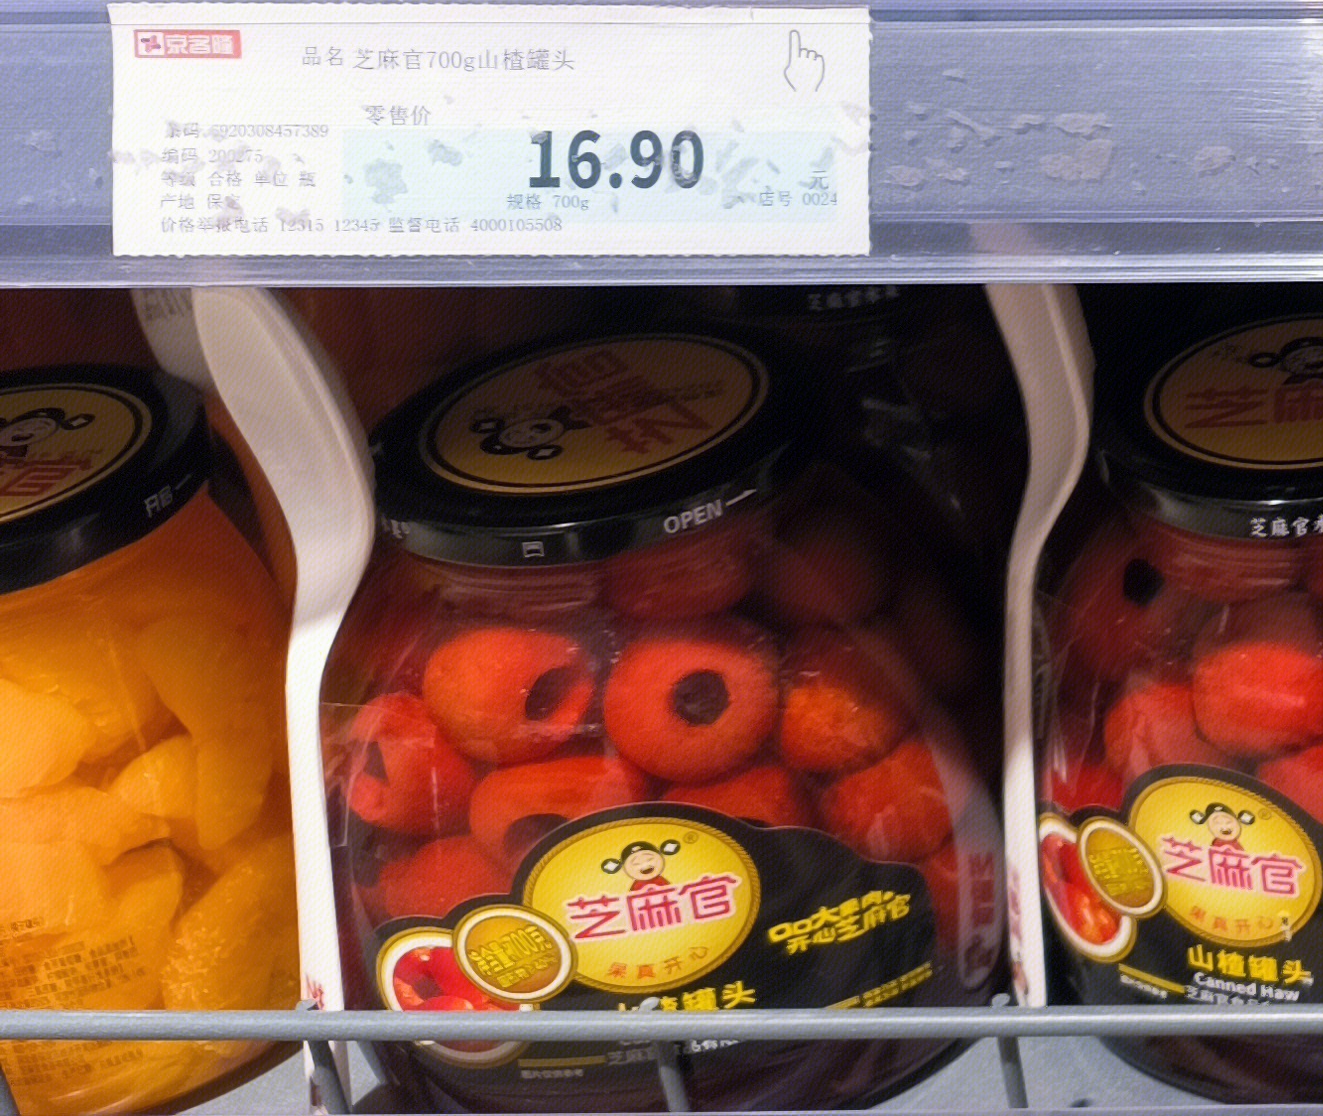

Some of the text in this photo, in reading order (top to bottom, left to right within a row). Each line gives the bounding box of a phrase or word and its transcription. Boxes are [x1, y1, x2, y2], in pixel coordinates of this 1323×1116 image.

[302, 46, 575, 72] 品名 芝麻官700g山楂罐头
[365, 105, 432, 126] 零售价
[162, 147, 198, 164] 编码
[529, 129, 704, 190] 16.90
[208, 171, 242, 187] 合格
[254, 171, 289, 187] 单位
[299, 171, 316, 187] 瓶
[810, 170, 829, 191] 元
[160, 193, 195, 210] 产地
[507, 194, 590, 211] 规格 700g
[758, 190, 838, 207] 店号 0024
[161, 216, 563, 233] 价格举报电话 12315 12345 监督电话 4000105508
[664, 499, 723, 535] OPEN
[1160, 835, 1306, 897] 芝麻官
[566, 875, 739, 943] 芝麻官
[607, 946, 711, 982] 果真开心
[1187, 944, 1312, 986] 山楂罐头
[1260, 984, 1300, 1002] Haw
